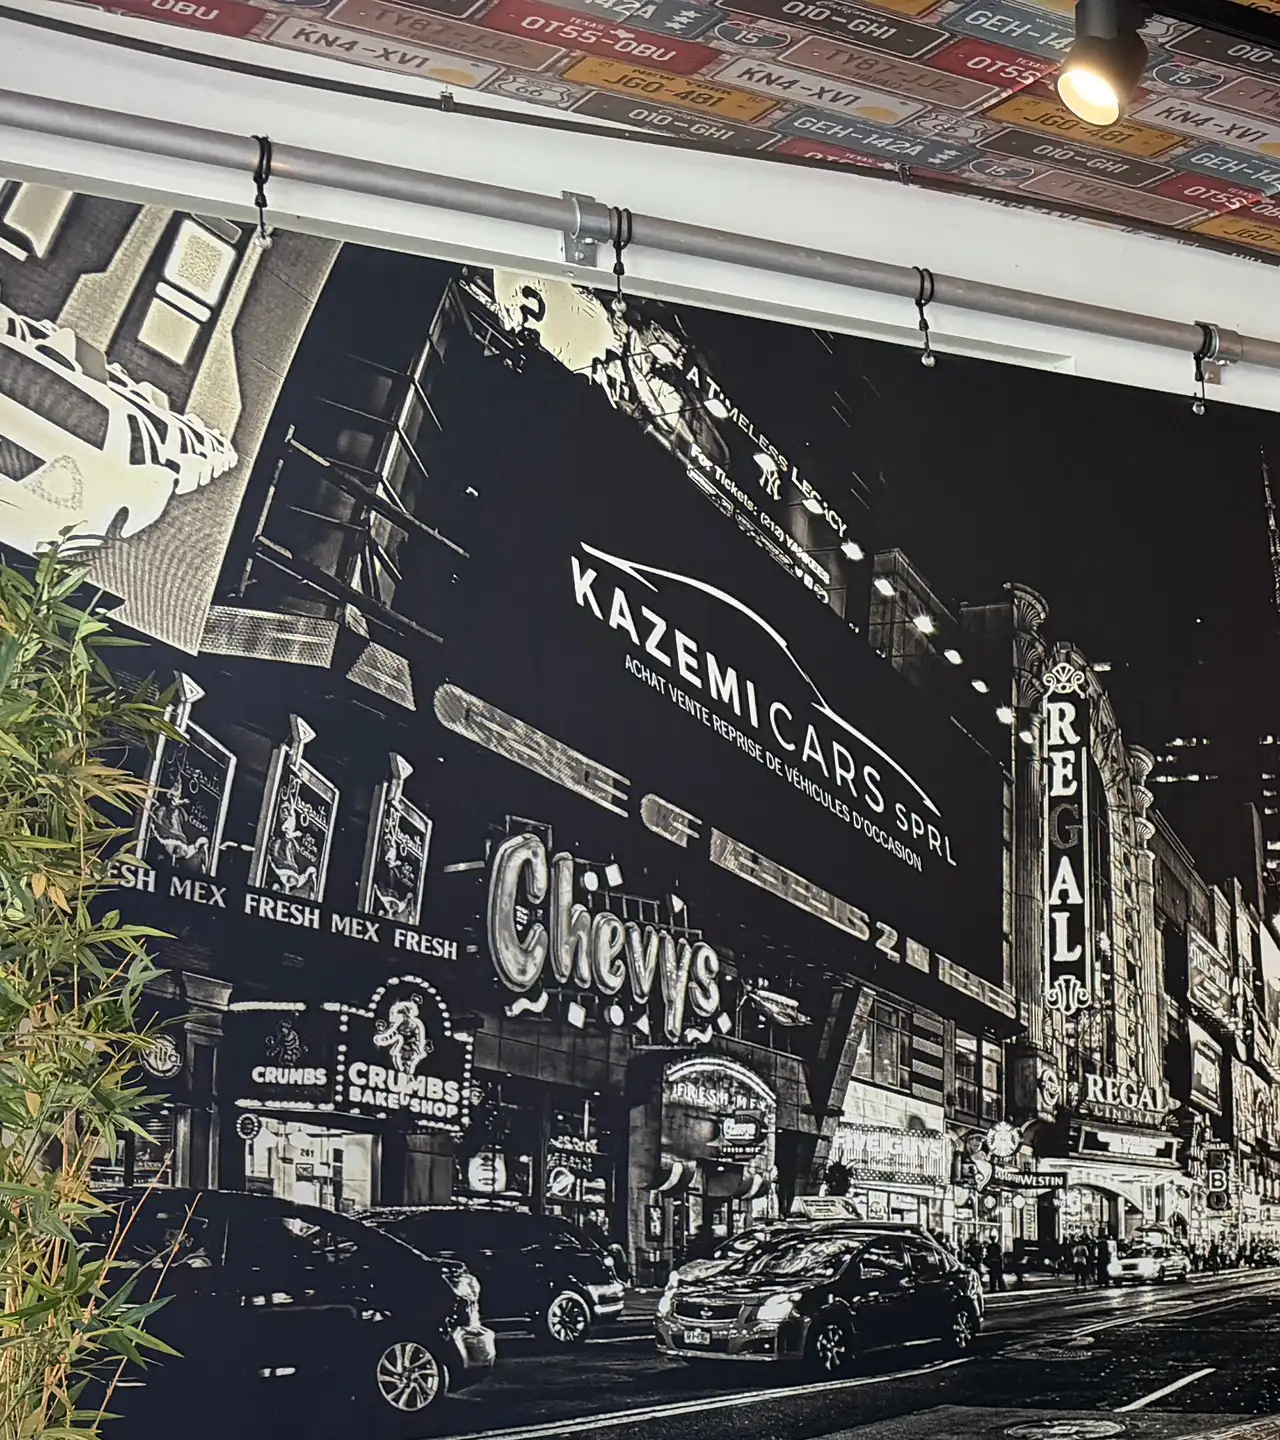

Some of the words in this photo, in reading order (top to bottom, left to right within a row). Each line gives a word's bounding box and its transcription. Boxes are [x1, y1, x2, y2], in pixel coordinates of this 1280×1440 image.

[734, 30, 758, 44] 15
[1168, 70, 1193, 85] 15
[571, 555, 759, 727] KAZEMI
[769, 702, 885, 813] CARS
[895, 802, 957, 866] SPRL
[625, 653, 667, 696] ACHAT
[669, 683, 711, 727] VENTE
[712, 713, 764, 764] REPRISE
[766, 754, 783, 778] DE
[784, 765, 850, 821] VÉHICULES
[852, 811, 923, 872] D'OCCASION
[1048, 701, 1083, 962] REGAL
[170, 876, 227, 908] MEX
[244, 893, 320, 930] FRESH
[331, 913, 381, 942] MEX
[393, 928, 457, 960] FRESH
[486, 832, 720, 1043] Chevys
[252, 1065, 328, 1086] CRUMBS
[349, 1061, 460, 1103] CRUMBS
[409, 1100, 459, 1119] SHOP
